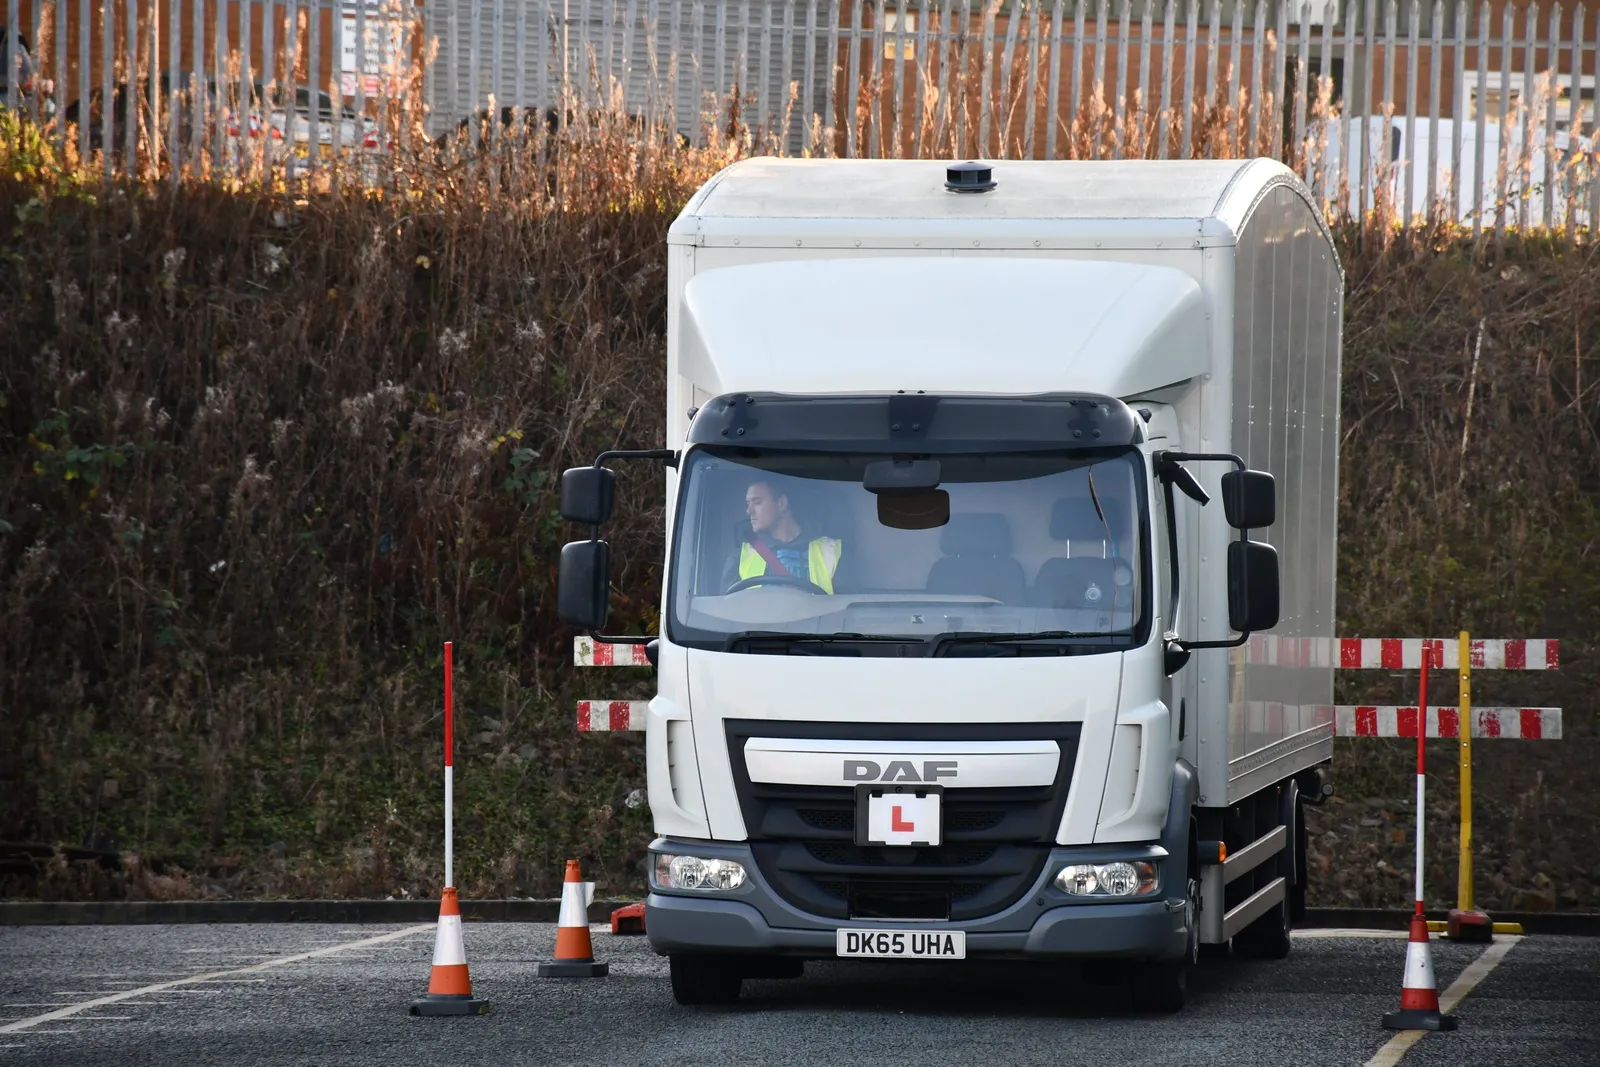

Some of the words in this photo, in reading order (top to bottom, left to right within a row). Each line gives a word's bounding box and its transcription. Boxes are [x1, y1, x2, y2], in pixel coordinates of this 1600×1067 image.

[843, 760, 958, 782] DAF
[891, 805, 915, 832] L
[846, 932, 905, 954] DK65
[912, 933, 956, 955] UHA
